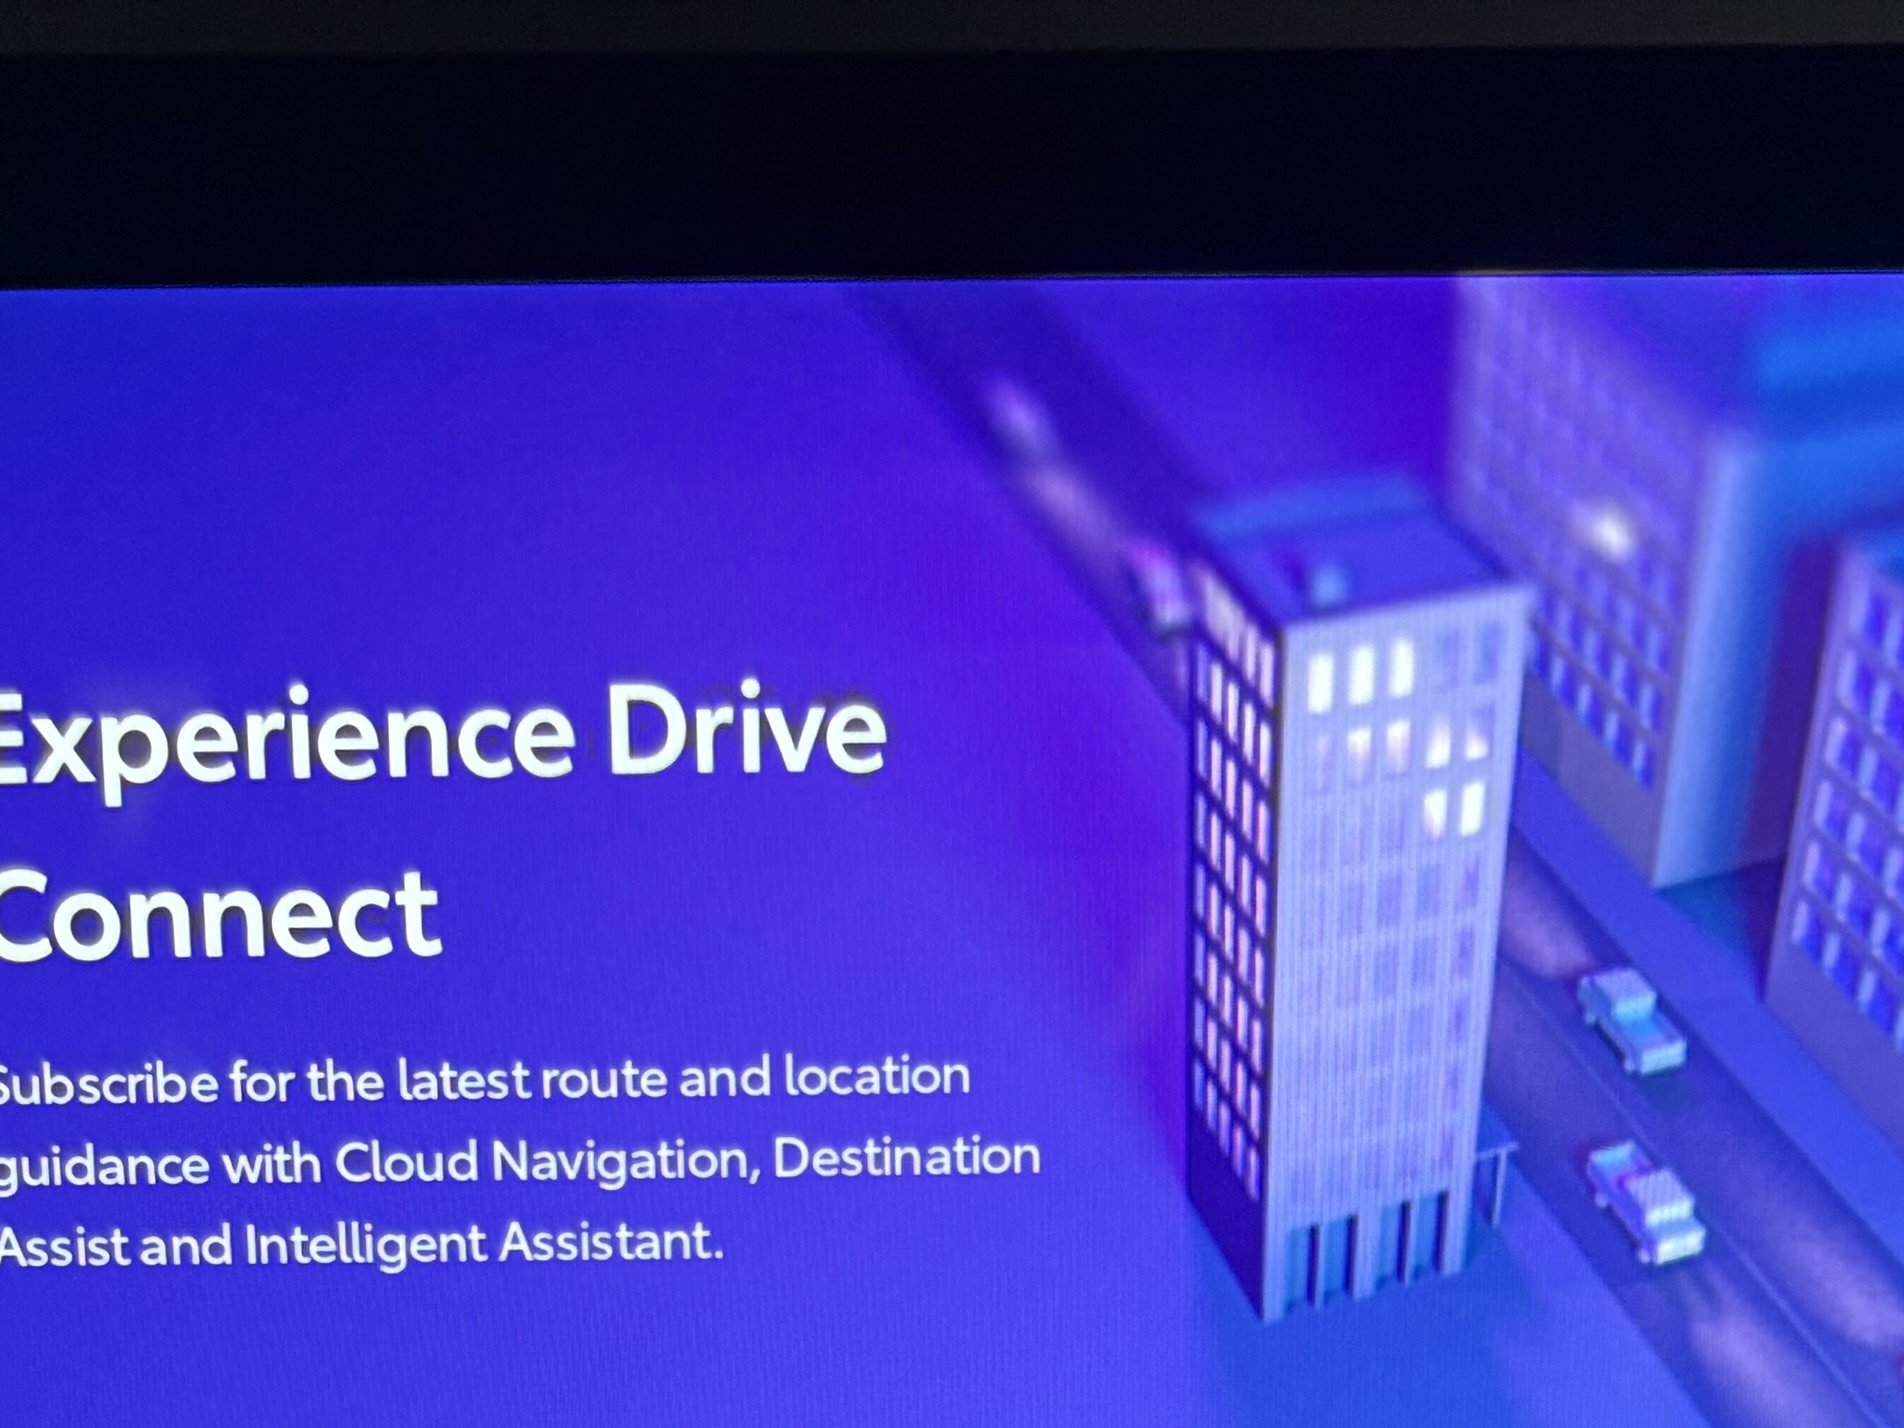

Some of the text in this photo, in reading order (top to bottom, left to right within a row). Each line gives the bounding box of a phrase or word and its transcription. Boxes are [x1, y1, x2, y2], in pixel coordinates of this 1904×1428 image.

[610, 678, 886, 774] Drive
[229, 1059, 295, 1102] for
[307, 1058, 384, 1101] the
[399, 1057, 532, 1100] latest
[543, 1060, 667, 1098] route
[680, 1053, 770, 1096] and
[786, 1053, 969, 1095] location
[222, 1140, 320, 1183] with
[336, 1139, 478, 1182] Cloud
[494, 1139, 760, 1189] Navigation,
[775, 1135, 1040, 1177] Destination
[140, 1222, 232, 1265] and
[247, 1221, 488, 1274] Intelligent
[499, 1221, 723, 1261] Assistant.
